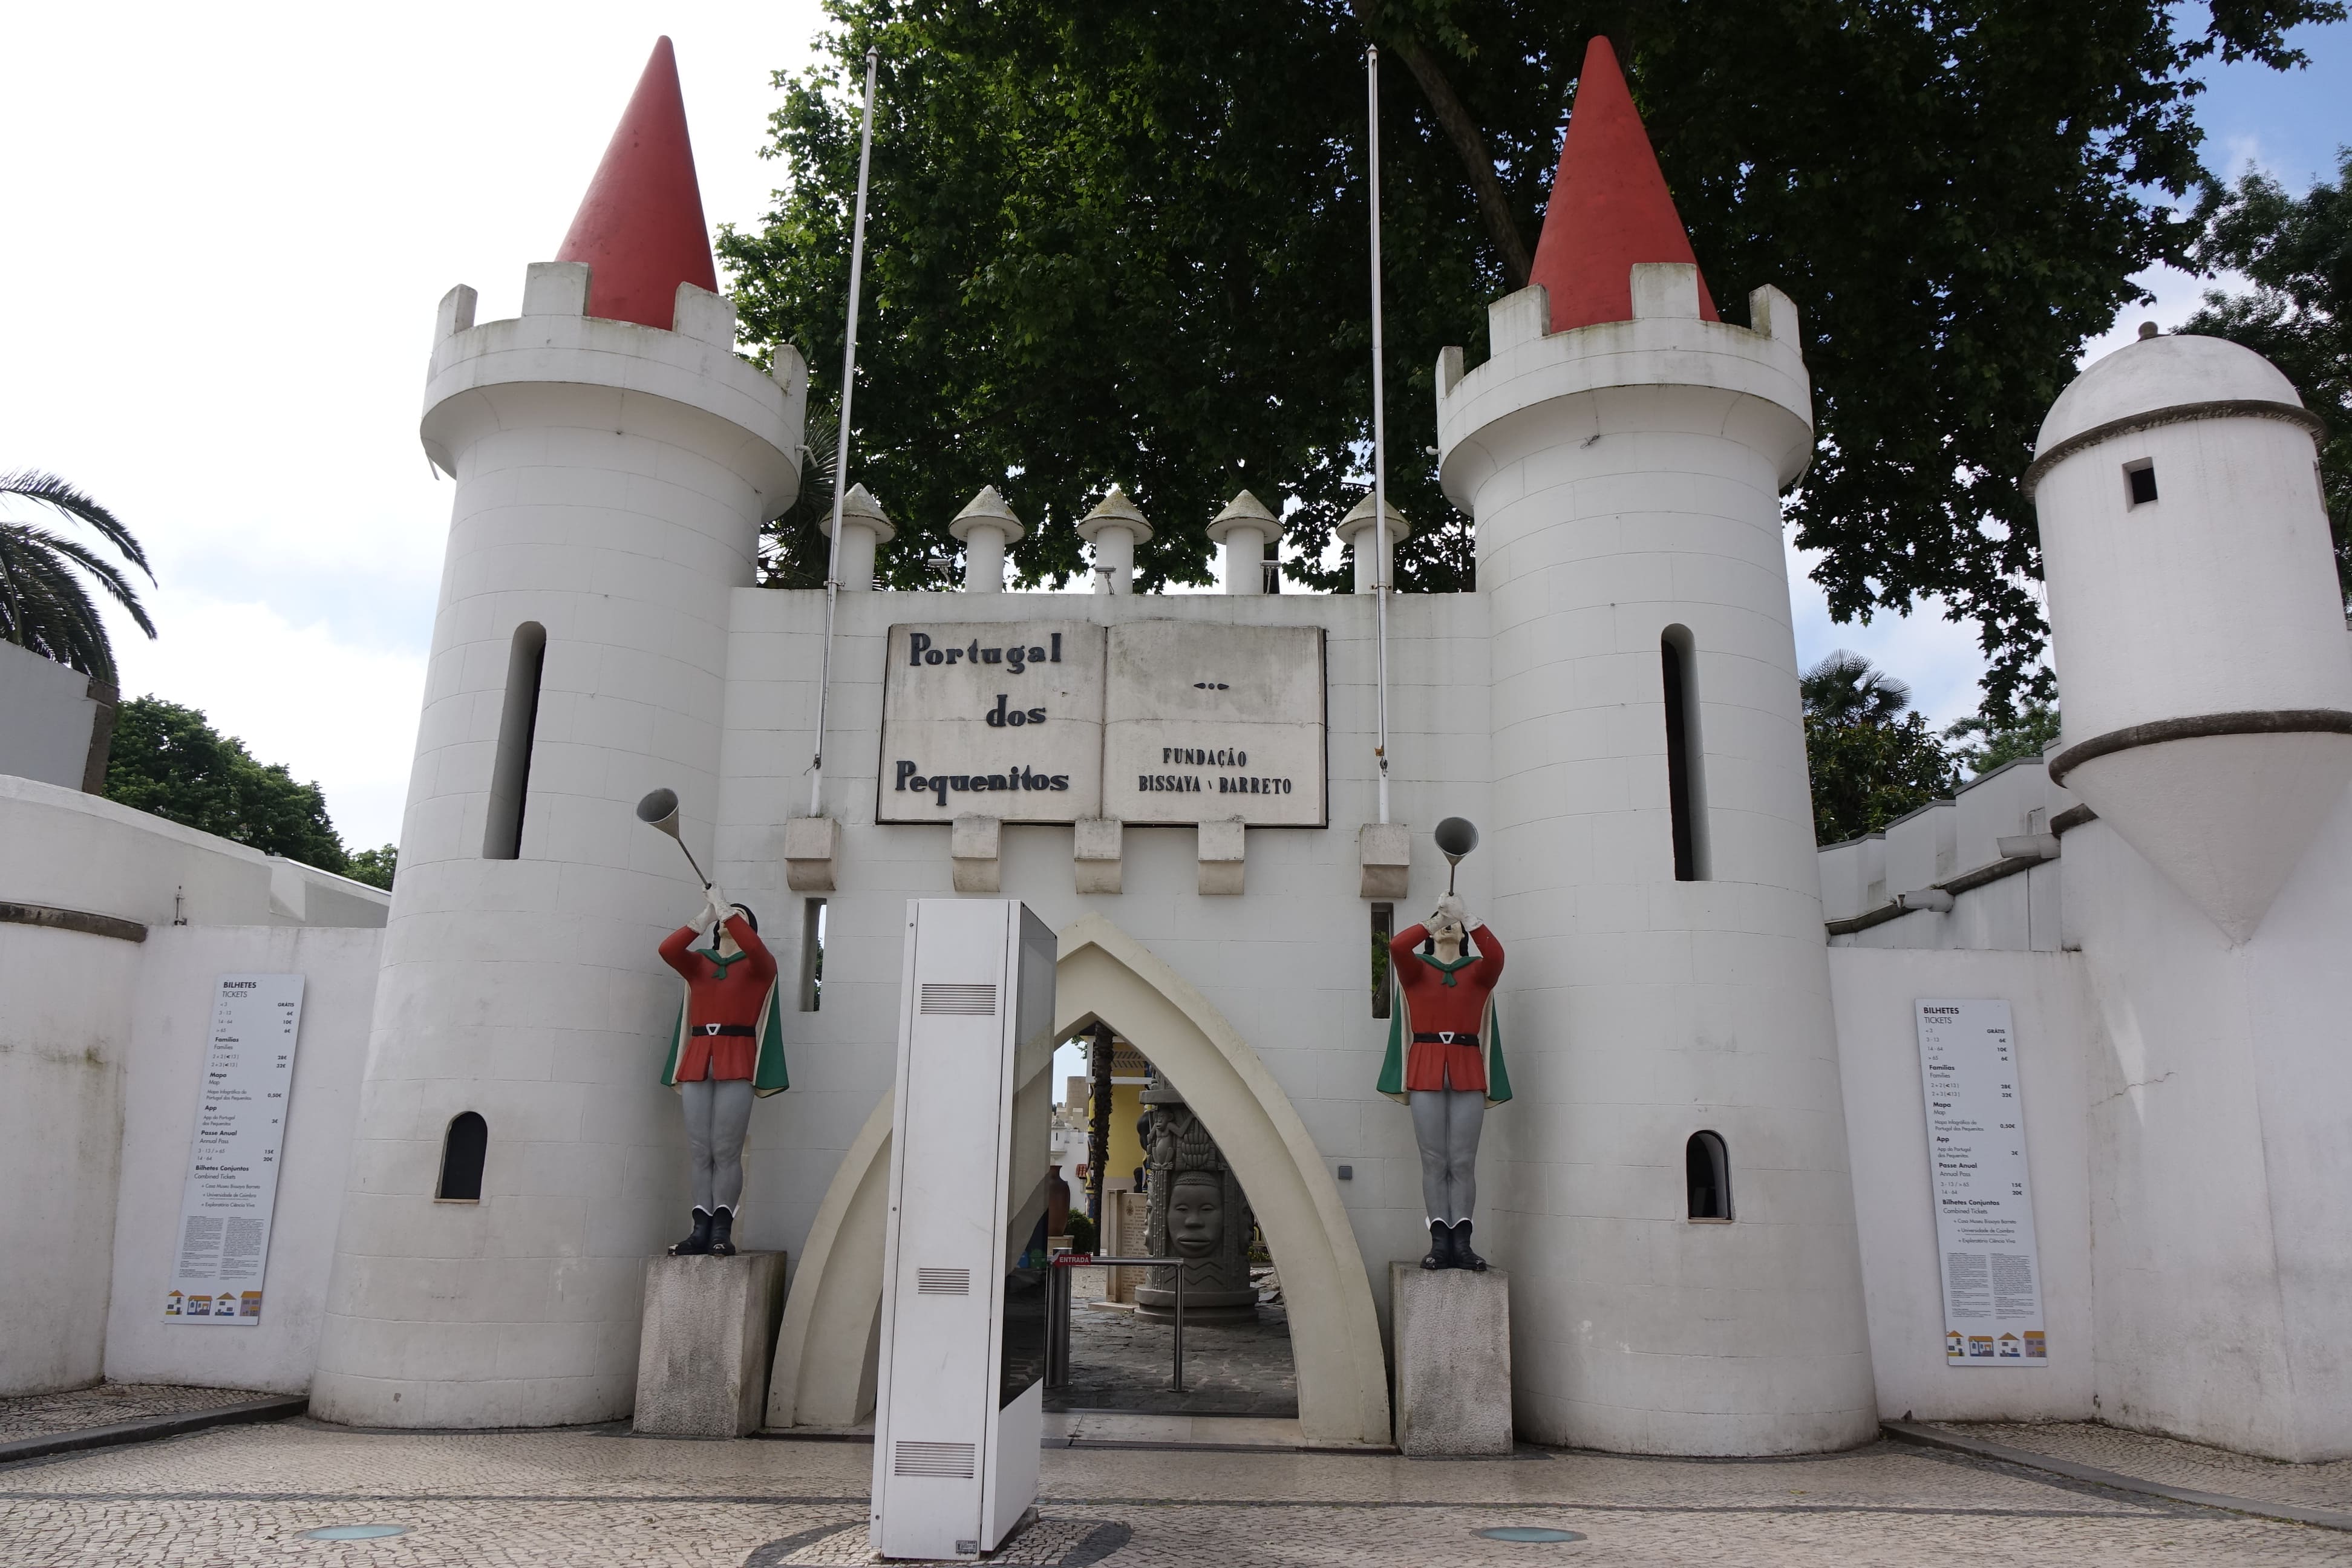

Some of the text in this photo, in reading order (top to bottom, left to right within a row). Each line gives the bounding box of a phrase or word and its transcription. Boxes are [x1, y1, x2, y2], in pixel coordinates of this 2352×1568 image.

[910, 633, 1062, 674] Portugal
[986, 694, 1045, 727] dos
[1163, 748, 1246, 767] FUNDAÇÃO
[895, 761, 1069, 806] Pequenitos
[1138, 775, 1292, 794] BISSAYA BARRETO
